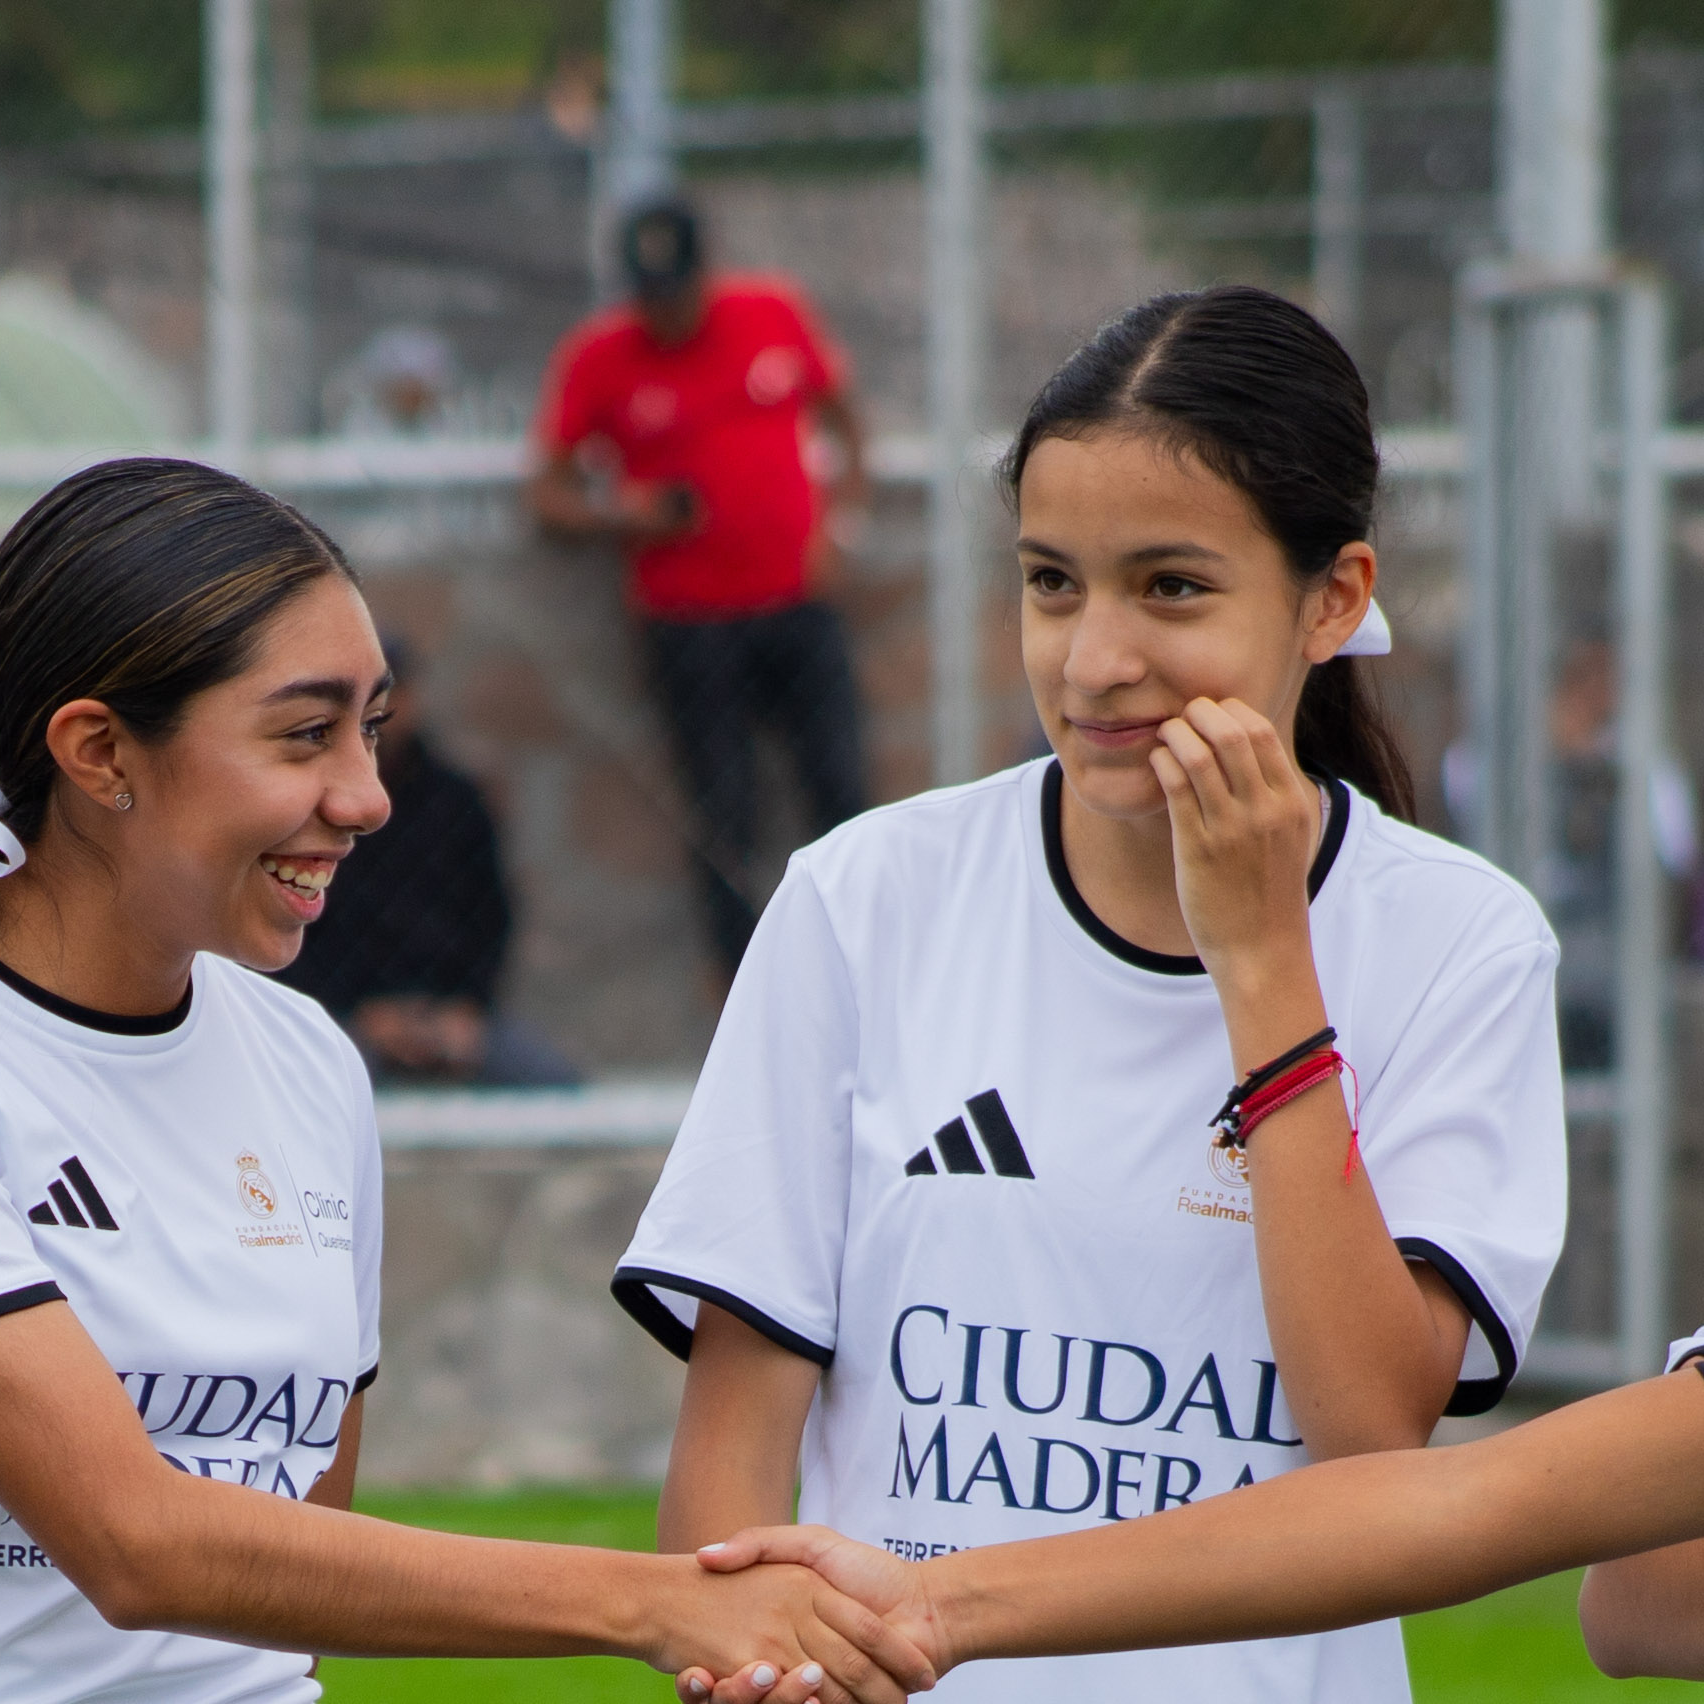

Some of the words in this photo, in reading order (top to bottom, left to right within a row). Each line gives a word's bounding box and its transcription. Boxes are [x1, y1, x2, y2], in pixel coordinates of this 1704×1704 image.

[304, 1190, 349, 1220] Clinic
[1180, 1186, 1250, 1206] FUNDAC
[116, 1372, 350, 1449] UDAD
